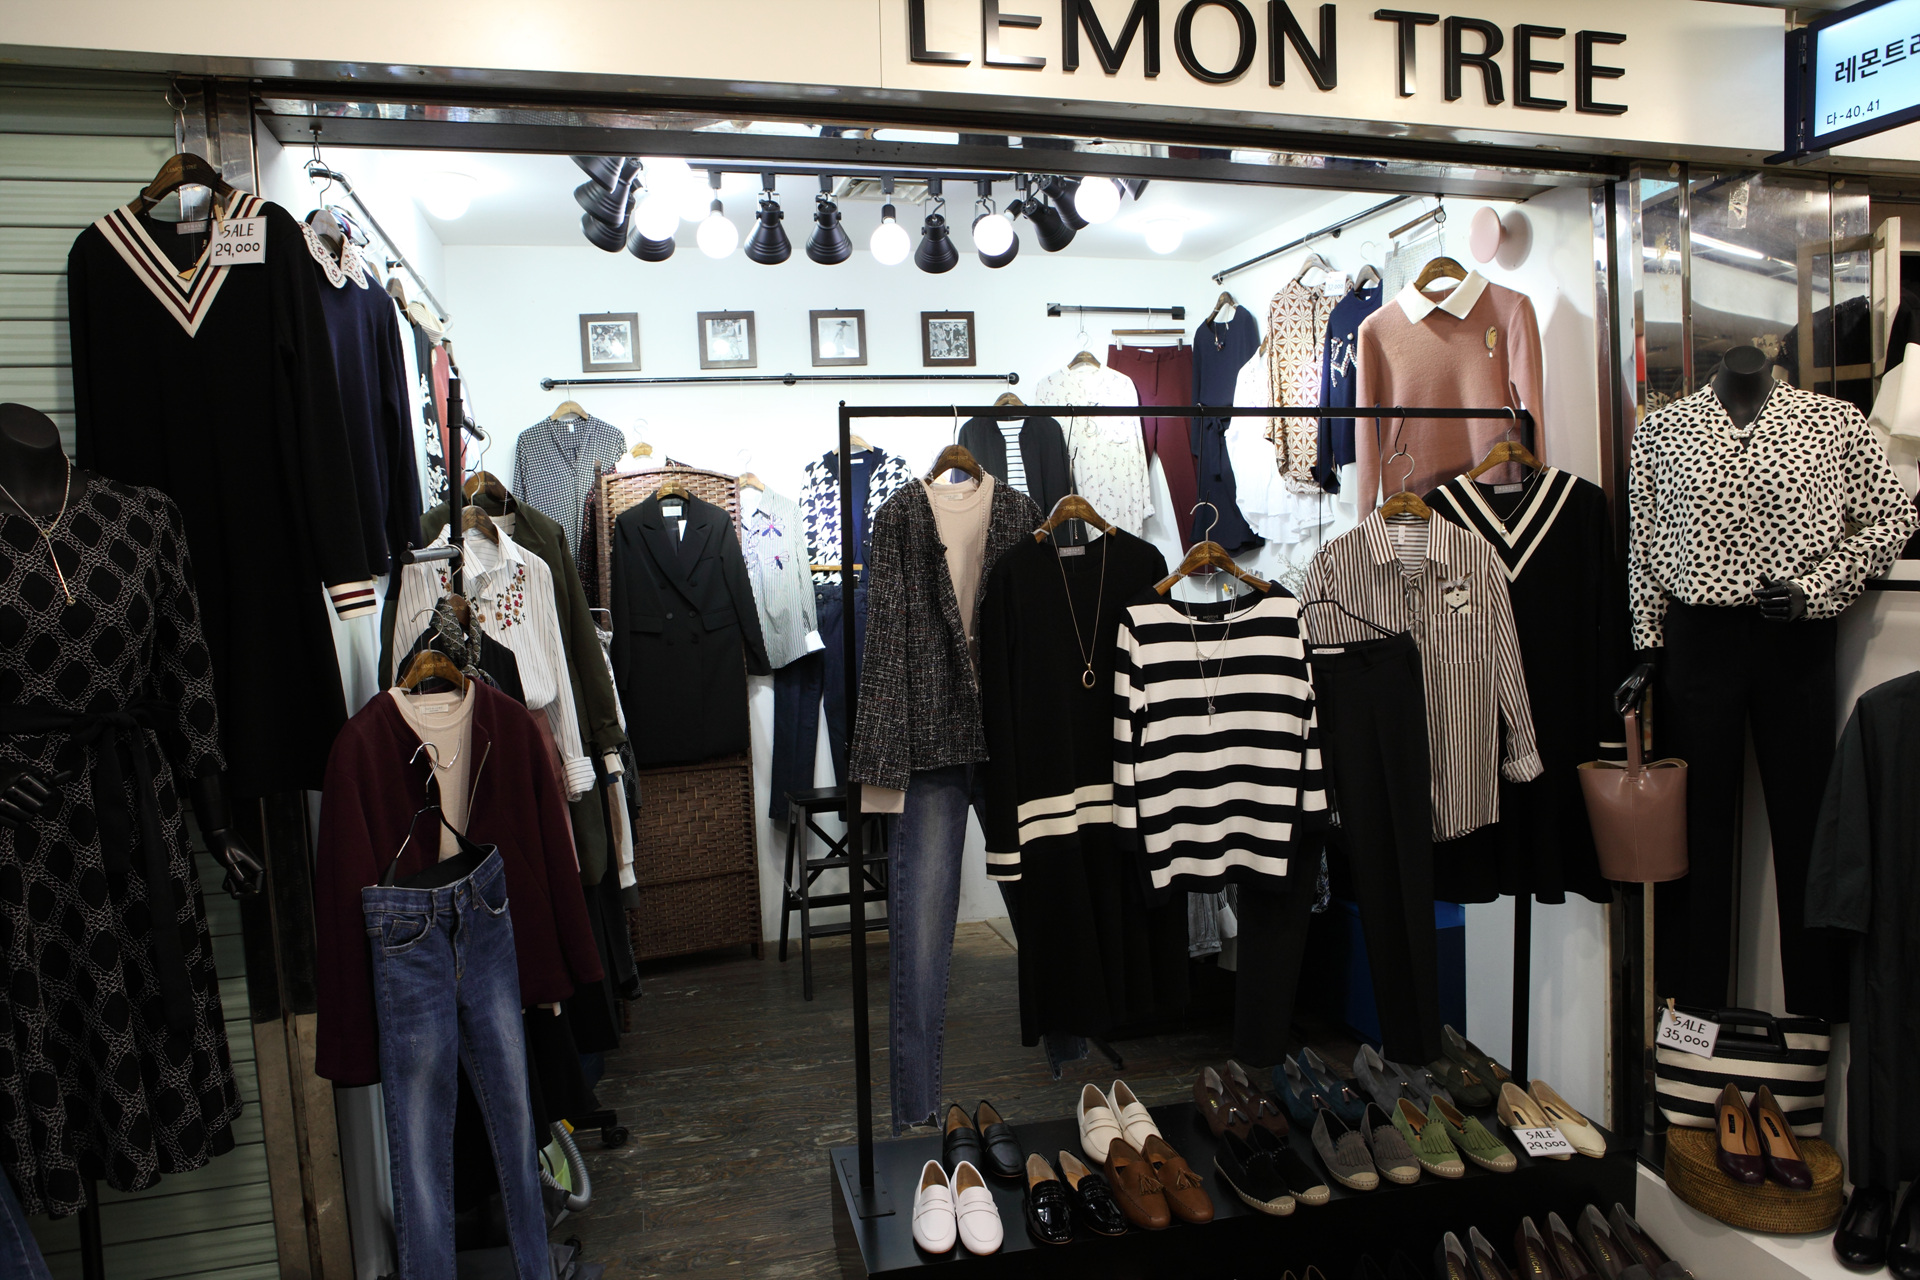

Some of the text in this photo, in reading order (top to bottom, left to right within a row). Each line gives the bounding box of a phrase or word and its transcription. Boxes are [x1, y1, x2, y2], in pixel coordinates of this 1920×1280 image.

[908, 0, 1628, 115] LEMON TREE
[223, 223, 254, 238] SALE
[215, 242, 260, 257] 29,000
[1673, 1016, 1707, 1035] SALE
[1662, 1027, 1710, 1048] 35,000
[1526, 1130, 1555, 1139] SALE
[1526, 1141, 1567, 1150] 29,000
